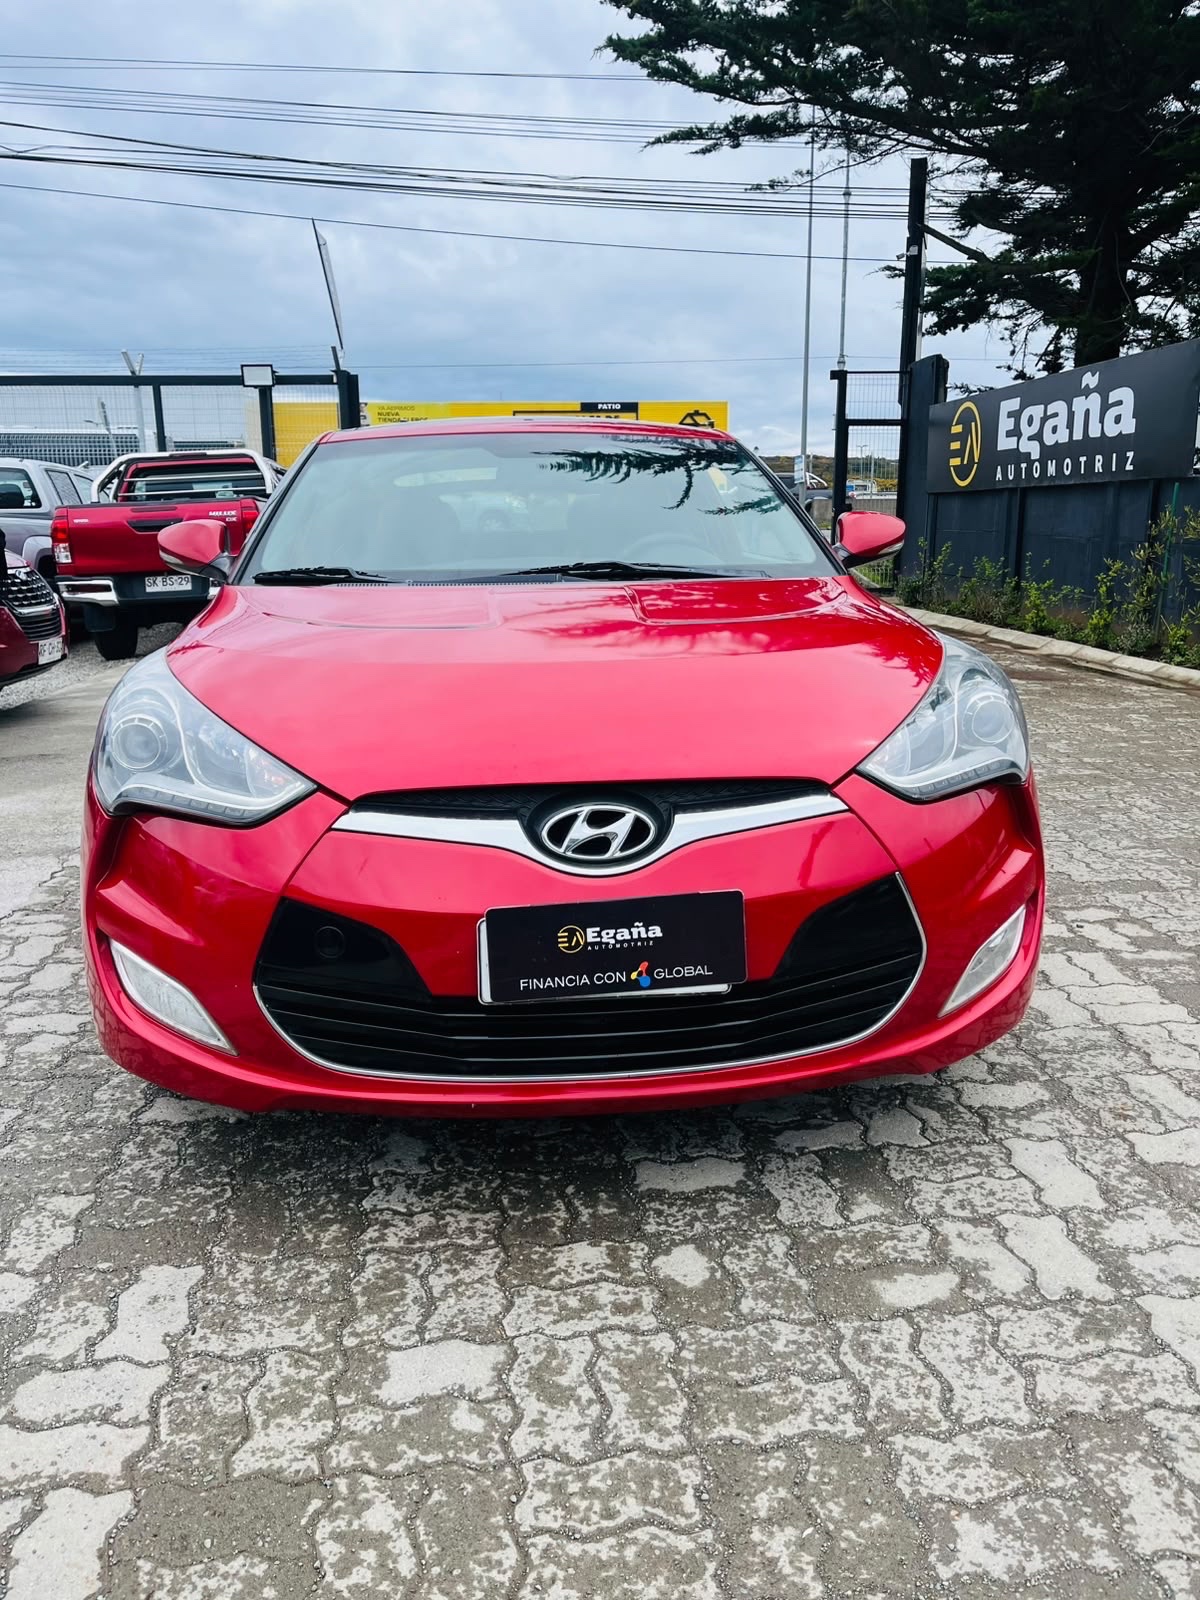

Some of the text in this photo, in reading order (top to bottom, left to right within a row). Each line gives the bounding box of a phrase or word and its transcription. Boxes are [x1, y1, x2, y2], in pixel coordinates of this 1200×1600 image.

[997, 371, 1136, 460] Egaña
[995, 451, 1135, 481] AUTOMOTRIZ
[586, 922, 663, 946] Egaña
[587, 940, 654, 951] AUTOMOTRIZ
[519, 964, 714, 991] FINANCIA CON GLOBAL
